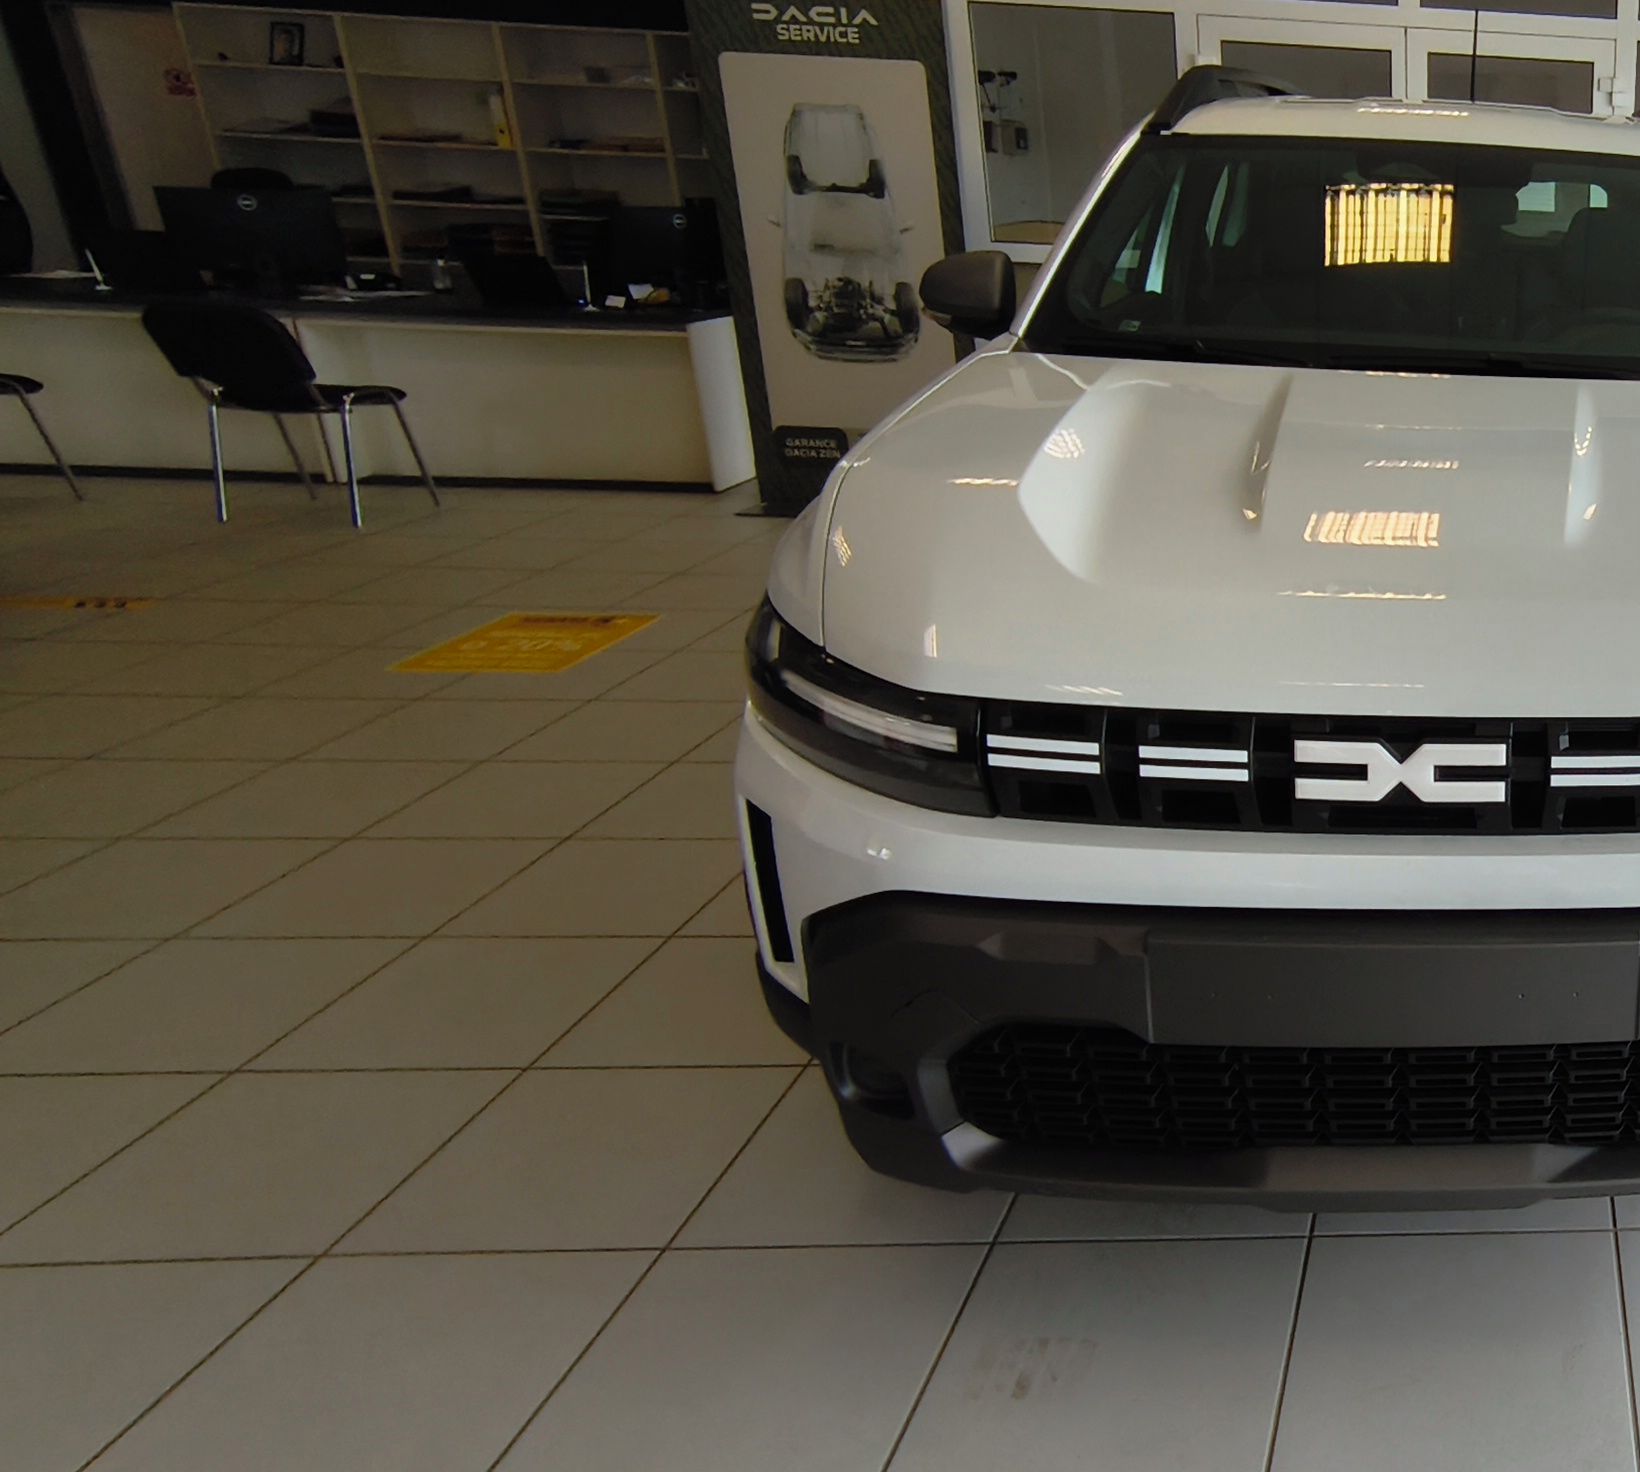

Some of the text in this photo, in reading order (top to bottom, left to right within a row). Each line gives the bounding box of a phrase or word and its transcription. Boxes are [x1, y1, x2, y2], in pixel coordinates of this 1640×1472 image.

[751, 3, 879, 25] DACIA
[776, 24, 860, 44] SERVICE
[785, 438, 837, 448] GARANCE
[784, 448, 817, 458] DACIA
